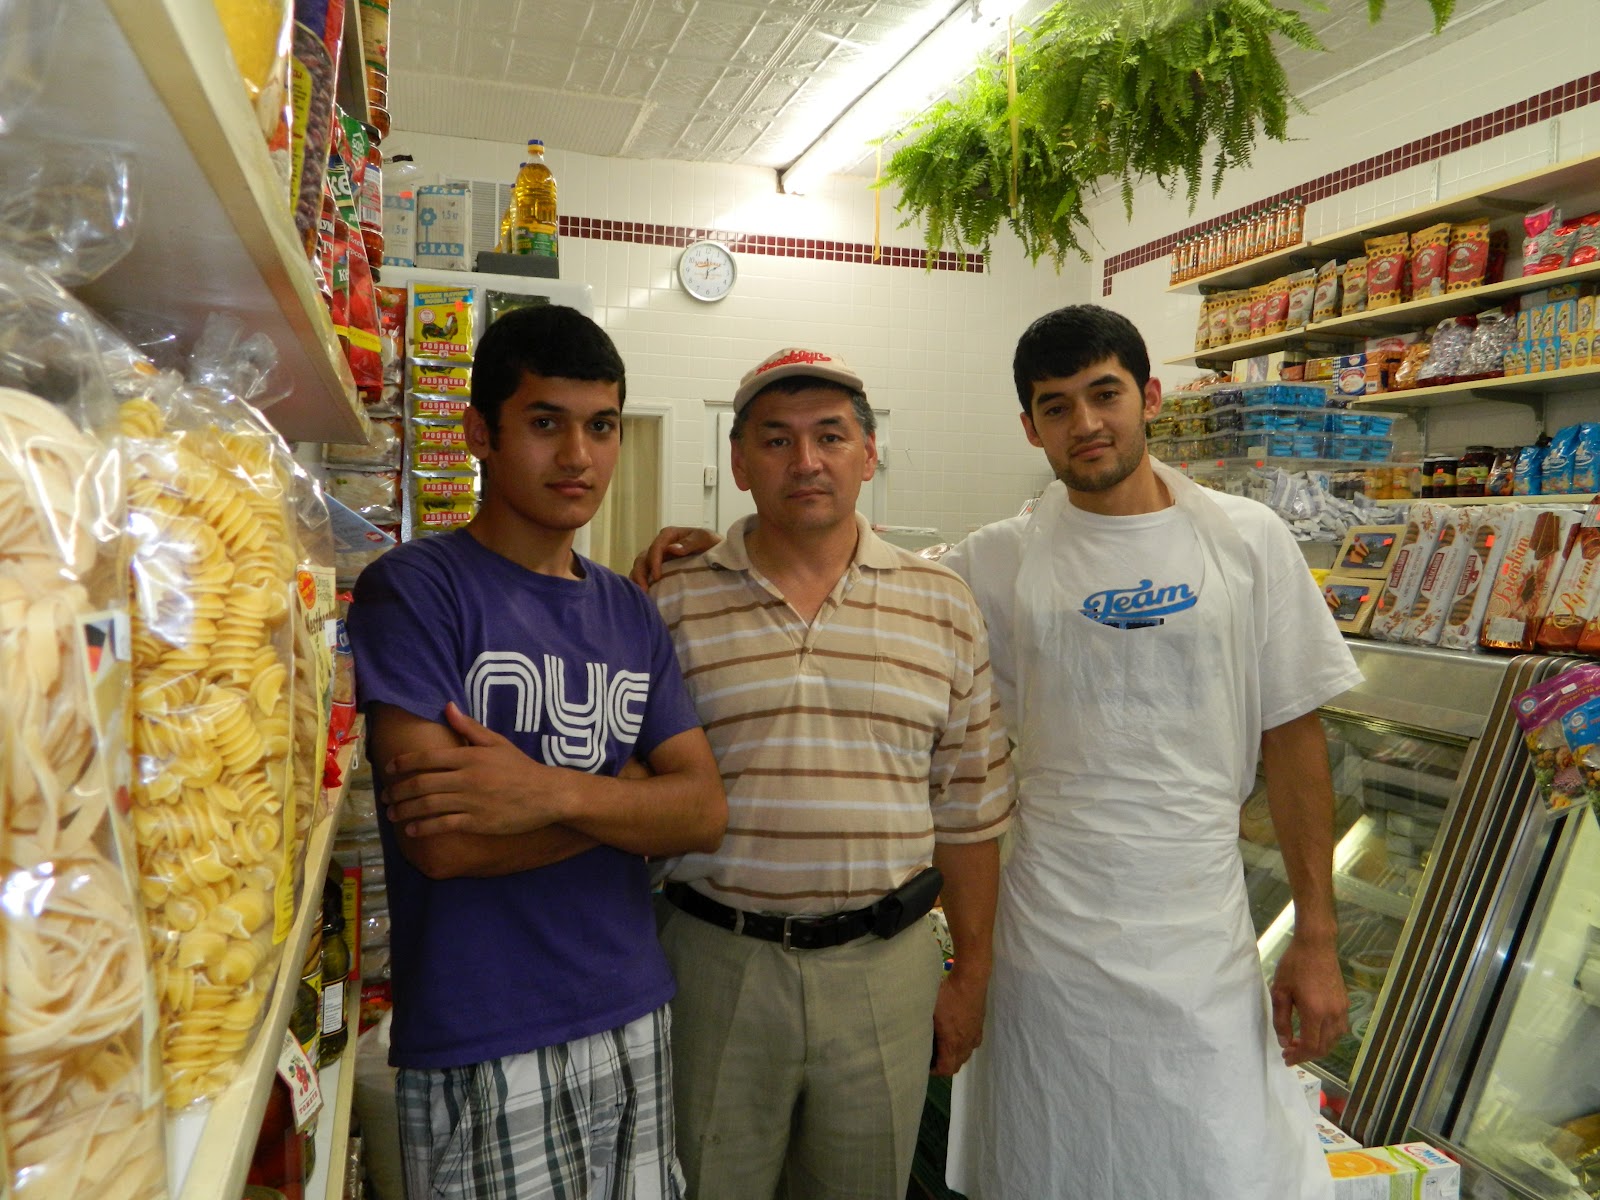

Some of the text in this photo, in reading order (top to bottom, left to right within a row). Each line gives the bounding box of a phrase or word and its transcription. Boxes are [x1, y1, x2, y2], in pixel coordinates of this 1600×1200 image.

[418, 243, 460, 255] СІЛЬ
[422, 342, 466, 352] PODRAVKA
[421, 377, 465, 385] PODRAVKA
[422, 402, 466, 410] PODRAVKA
[425, 513, 469, 521] PODRAVKA
[1083, 579, 1195, 620] Team
[465, 651, 650, 774] nyc
